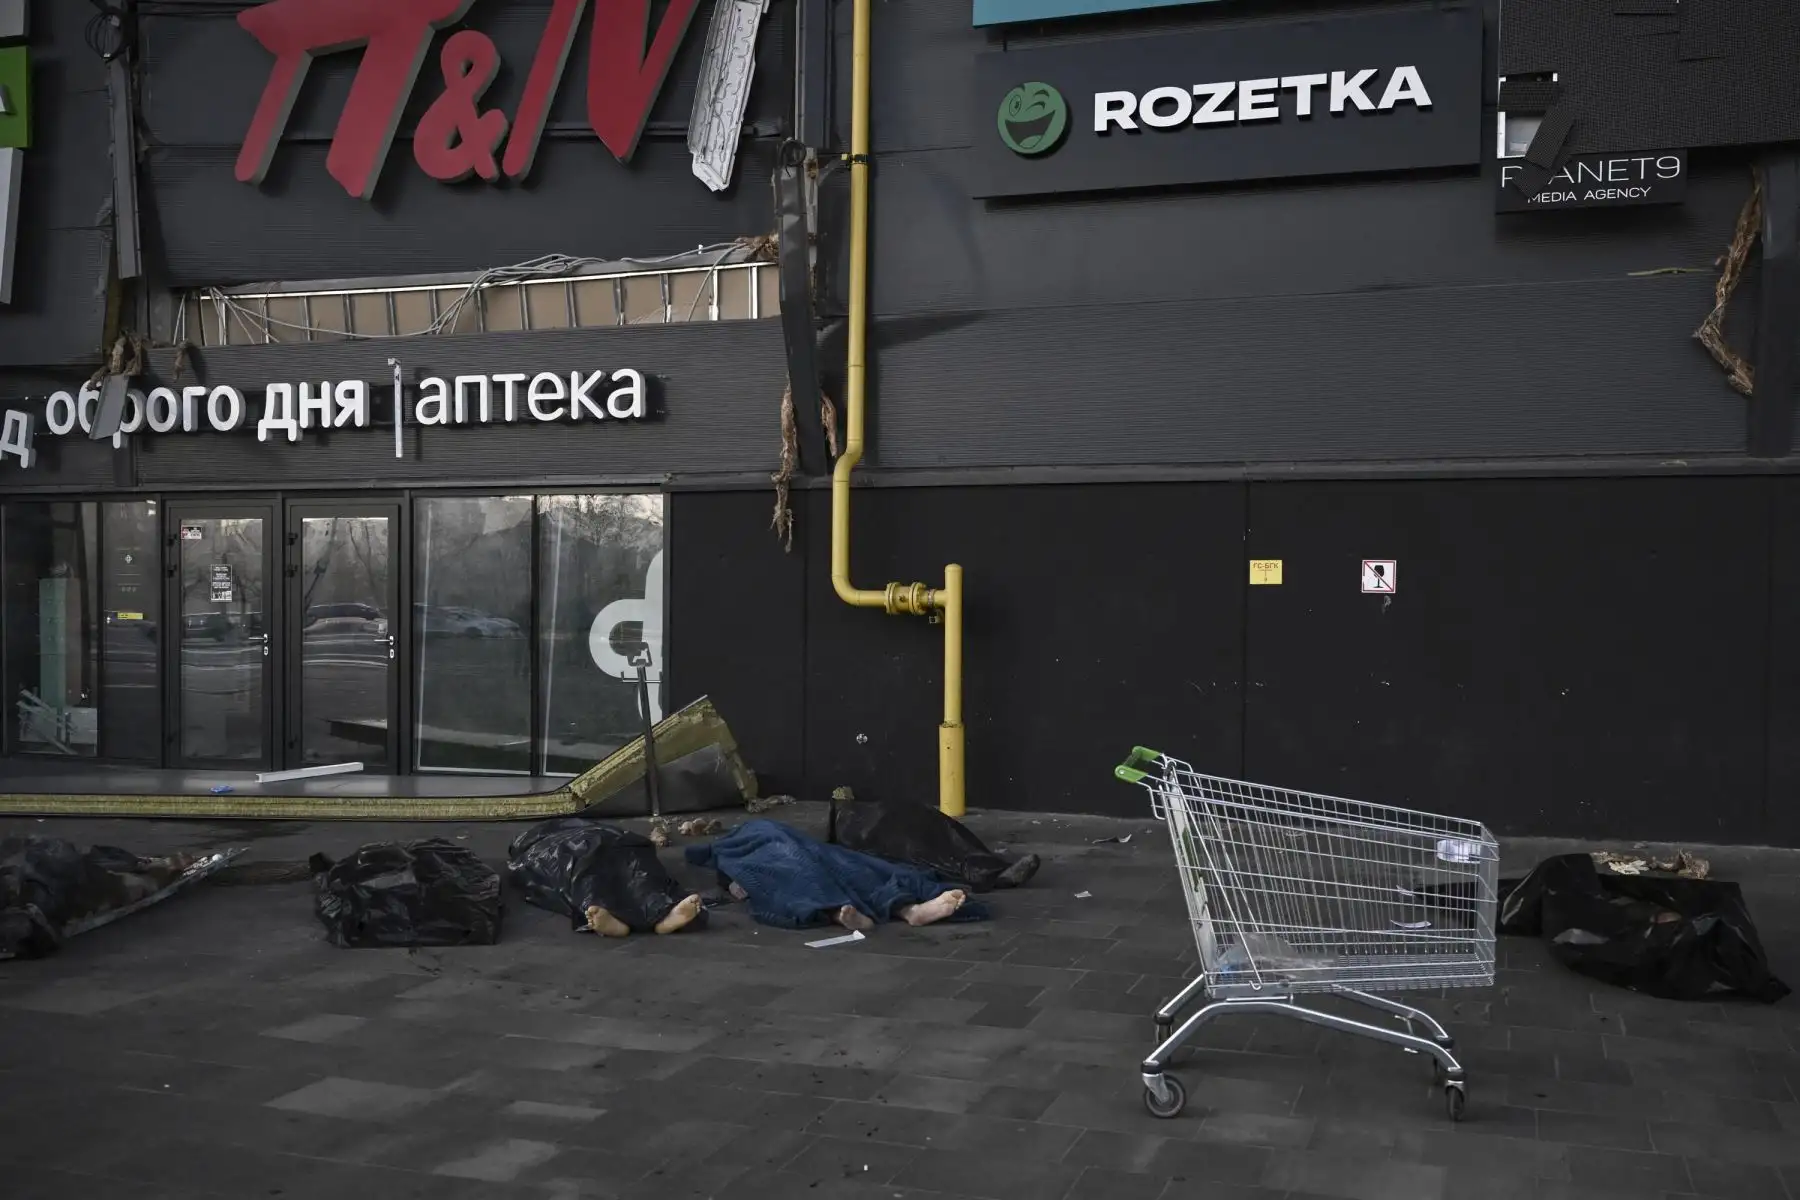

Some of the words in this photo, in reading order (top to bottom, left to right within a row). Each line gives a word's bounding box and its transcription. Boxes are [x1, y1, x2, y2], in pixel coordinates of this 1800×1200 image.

[1093, 66, 1432, 132] ROZETKA
[1501, 156, 1680, 188] PANET9
[1584, 186, 1652, 201] AGENCY
[257, 380, 366, 442] дня
[415, 368, 643, 425] аптека
